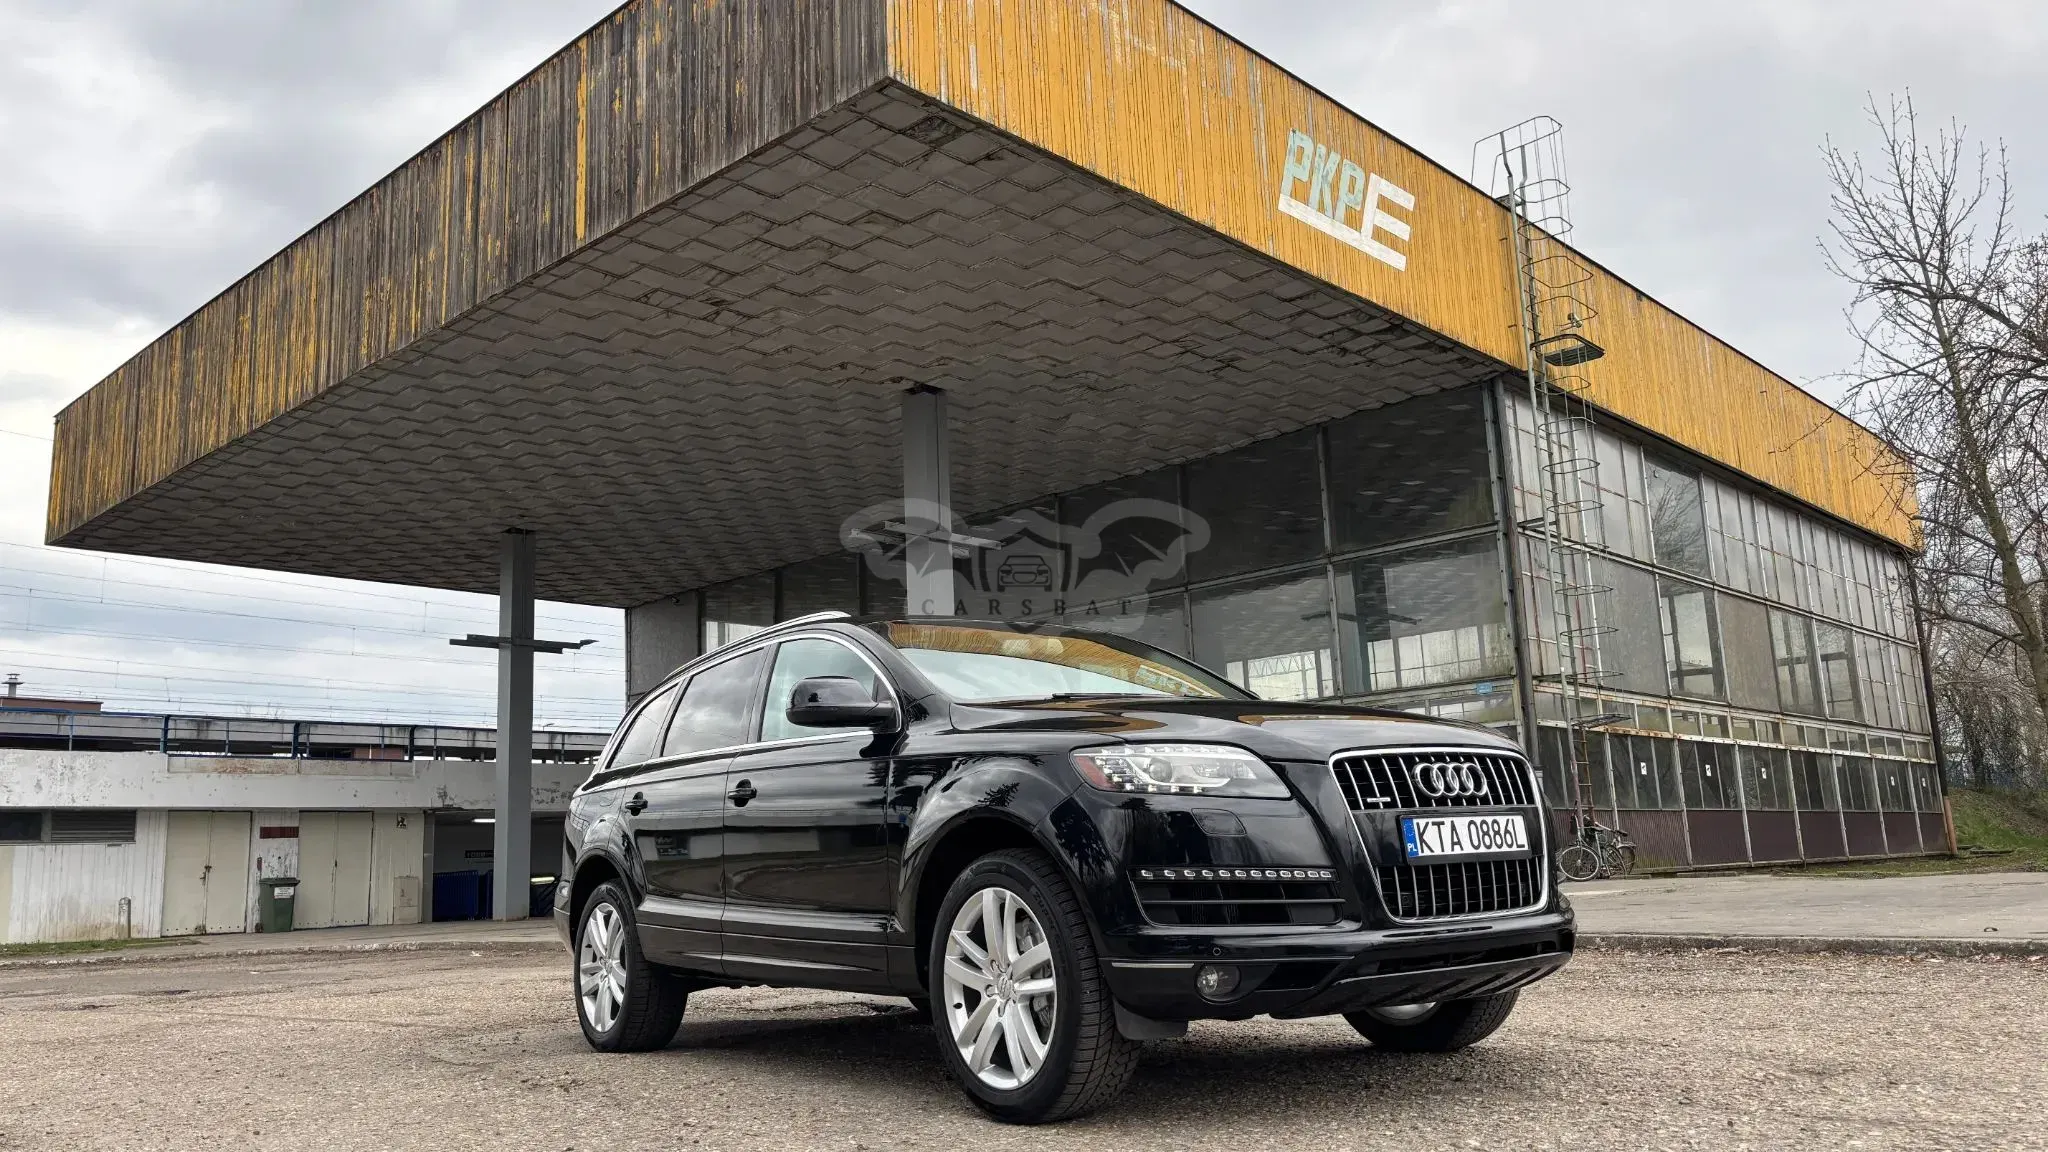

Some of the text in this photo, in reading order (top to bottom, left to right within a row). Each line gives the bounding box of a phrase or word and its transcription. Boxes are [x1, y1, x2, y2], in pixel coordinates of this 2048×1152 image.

[1416, 818, 1526, 854] KTA 0886L
[1407, 843, 1417, 852] PL
